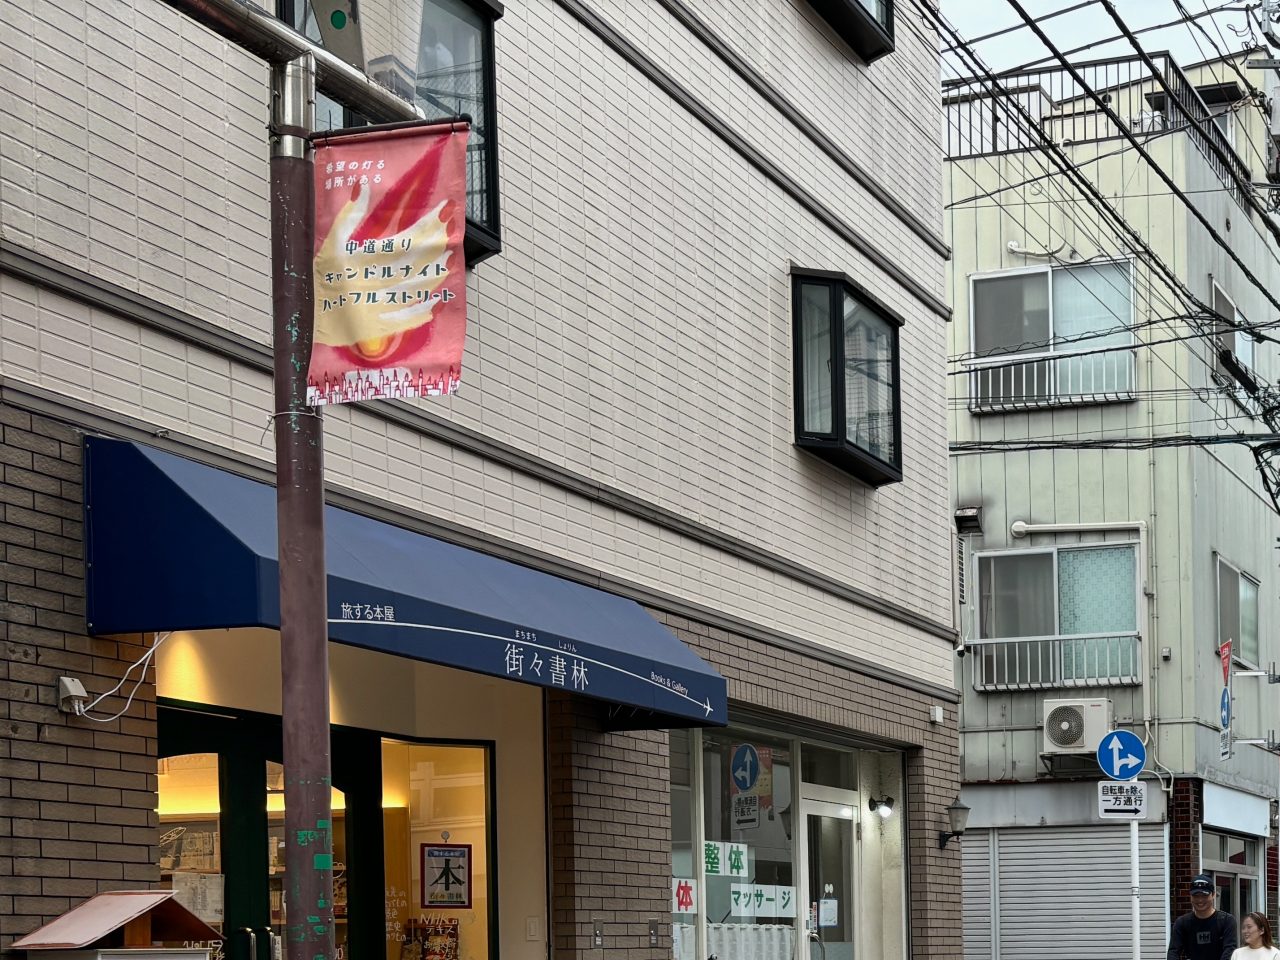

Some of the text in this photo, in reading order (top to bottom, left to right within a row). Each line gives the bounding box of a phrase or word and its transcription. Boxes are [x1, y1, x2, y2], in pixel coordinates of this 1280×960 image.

[326, 160, 385, 174] 希望の灯る
[325, 174, 382, 190] 場所がある
[345, 238, 412, 255] 中道通り
[325, 263, 448, 283] キャンドルナイト
[323, 289, 456, 311] ハートフルストリート
[341, 602, 396, 621] 旅する本屋
[514, 629, 537, 642] まちまち
[558, 640, 578, 653] しょりん
[504, 643, 589, 691] 街々書林
[650, 671, 667, 686] Books
[671, 680, 689, 696] Gallery
[1102, 785, 1143, 796] 自転車を除く
[1102, 796, 1143, 807] 一方通行
[704, 842, 745, 875] 整体
[429, 858, 465, 891] 本
[676, 880, 694, 912] 体
[731, 889, 791, 911] マッサージ
